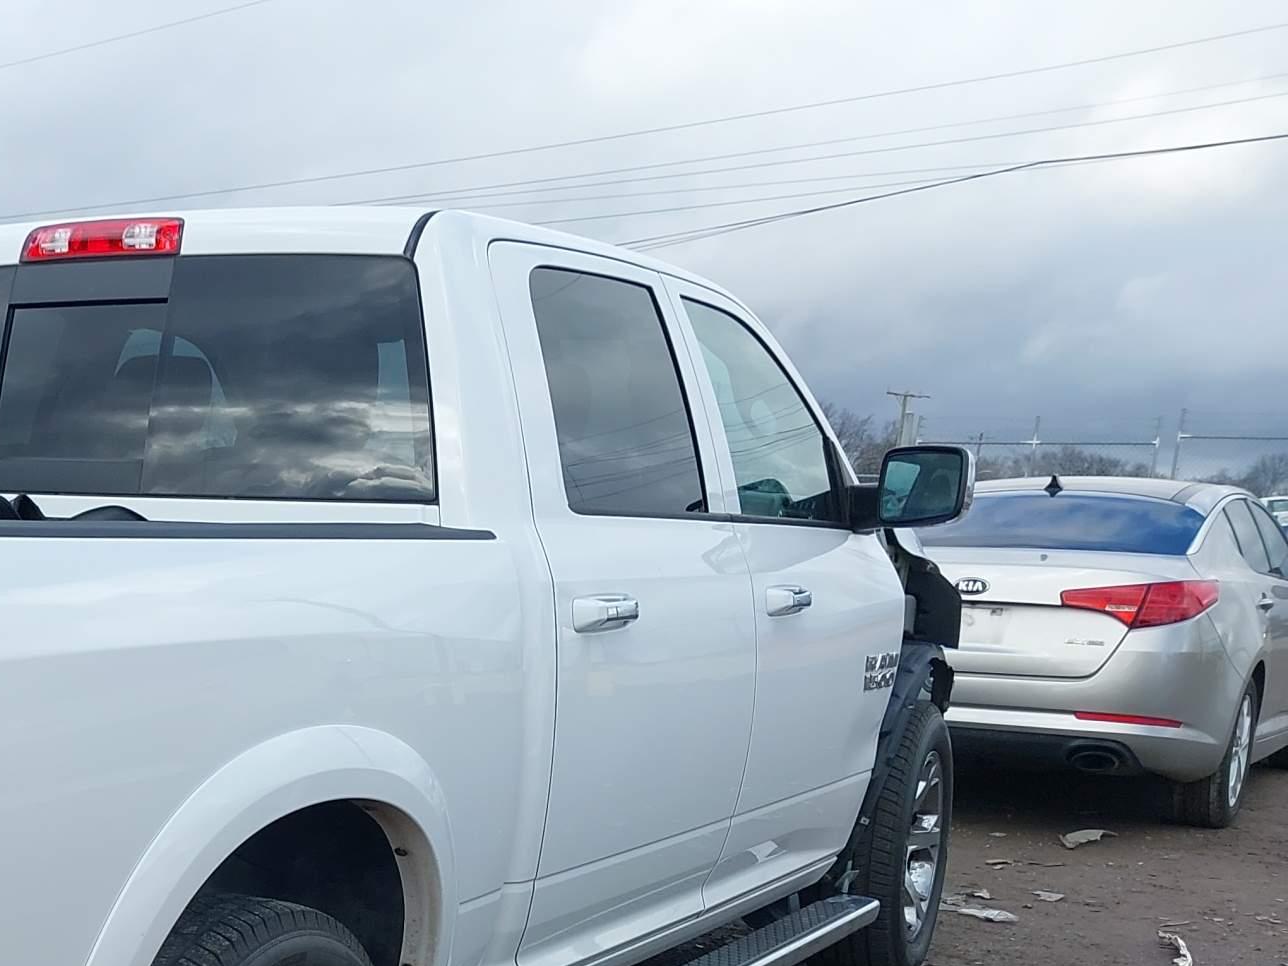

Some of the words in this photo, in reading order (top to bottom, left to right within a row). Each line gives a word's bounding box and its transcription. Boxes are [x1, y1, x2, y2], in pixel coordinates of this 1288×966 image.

[958, 580, 984, 592] KIA
[864, 651, 900, 673] RAM
[862, 668, 896, 693] 1500
